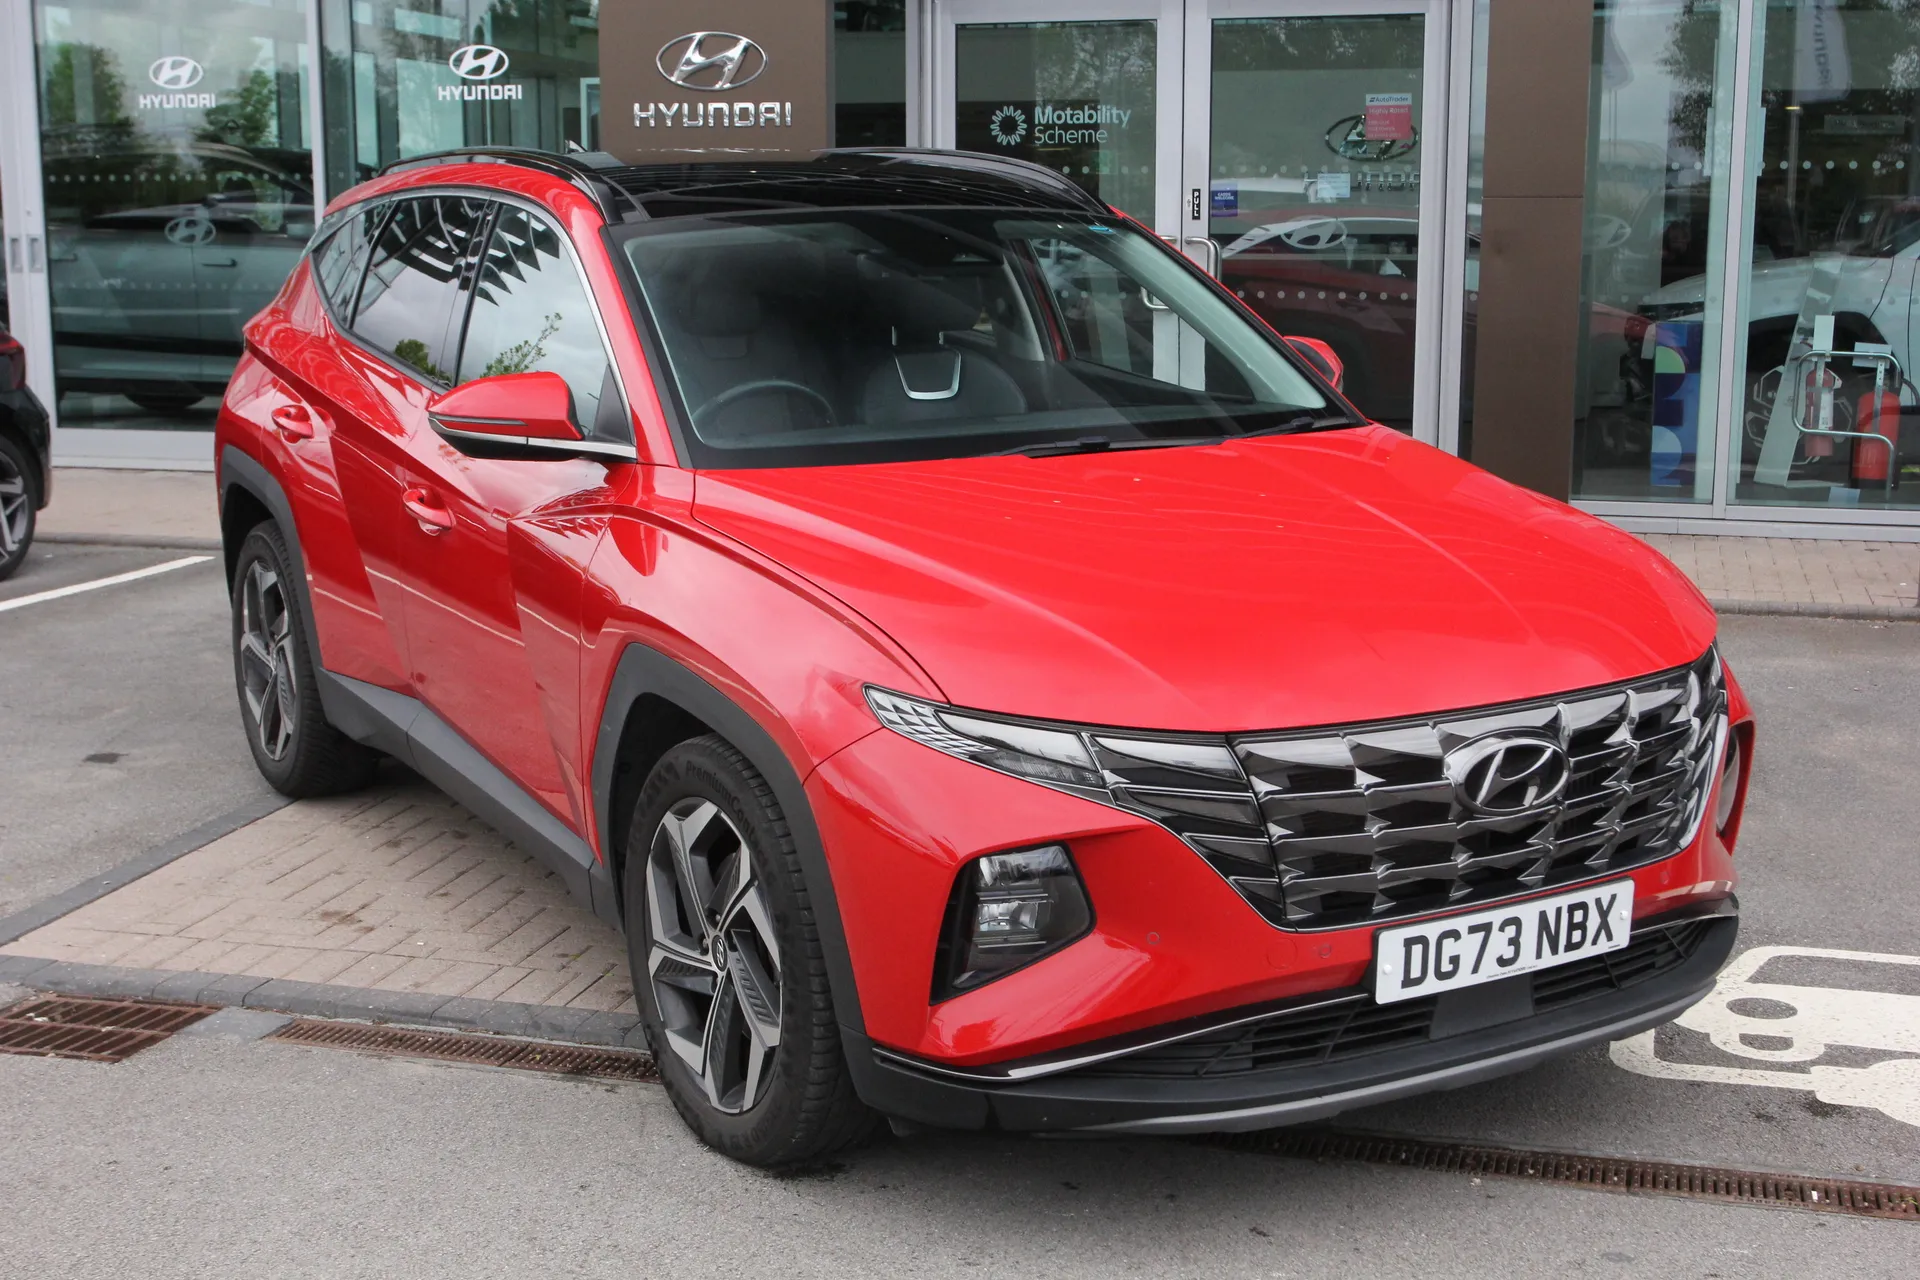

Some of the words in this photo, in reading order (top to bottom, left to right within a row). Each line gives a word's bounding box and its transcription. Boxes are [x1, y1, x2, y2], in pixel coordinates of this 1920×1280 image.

[139, 93, 216, 109] HYUNDAI
[437, 84, 523, 101] HYUNDAI
[632, 102, 793, 128] HYUNDAI
[1034, 105, 1131, 128] Motability
[1034, 126, 1108, 144] Scheme
[1400, 916, 1522, 989] DG73
[1534, 893, 1617, 960] NBX
